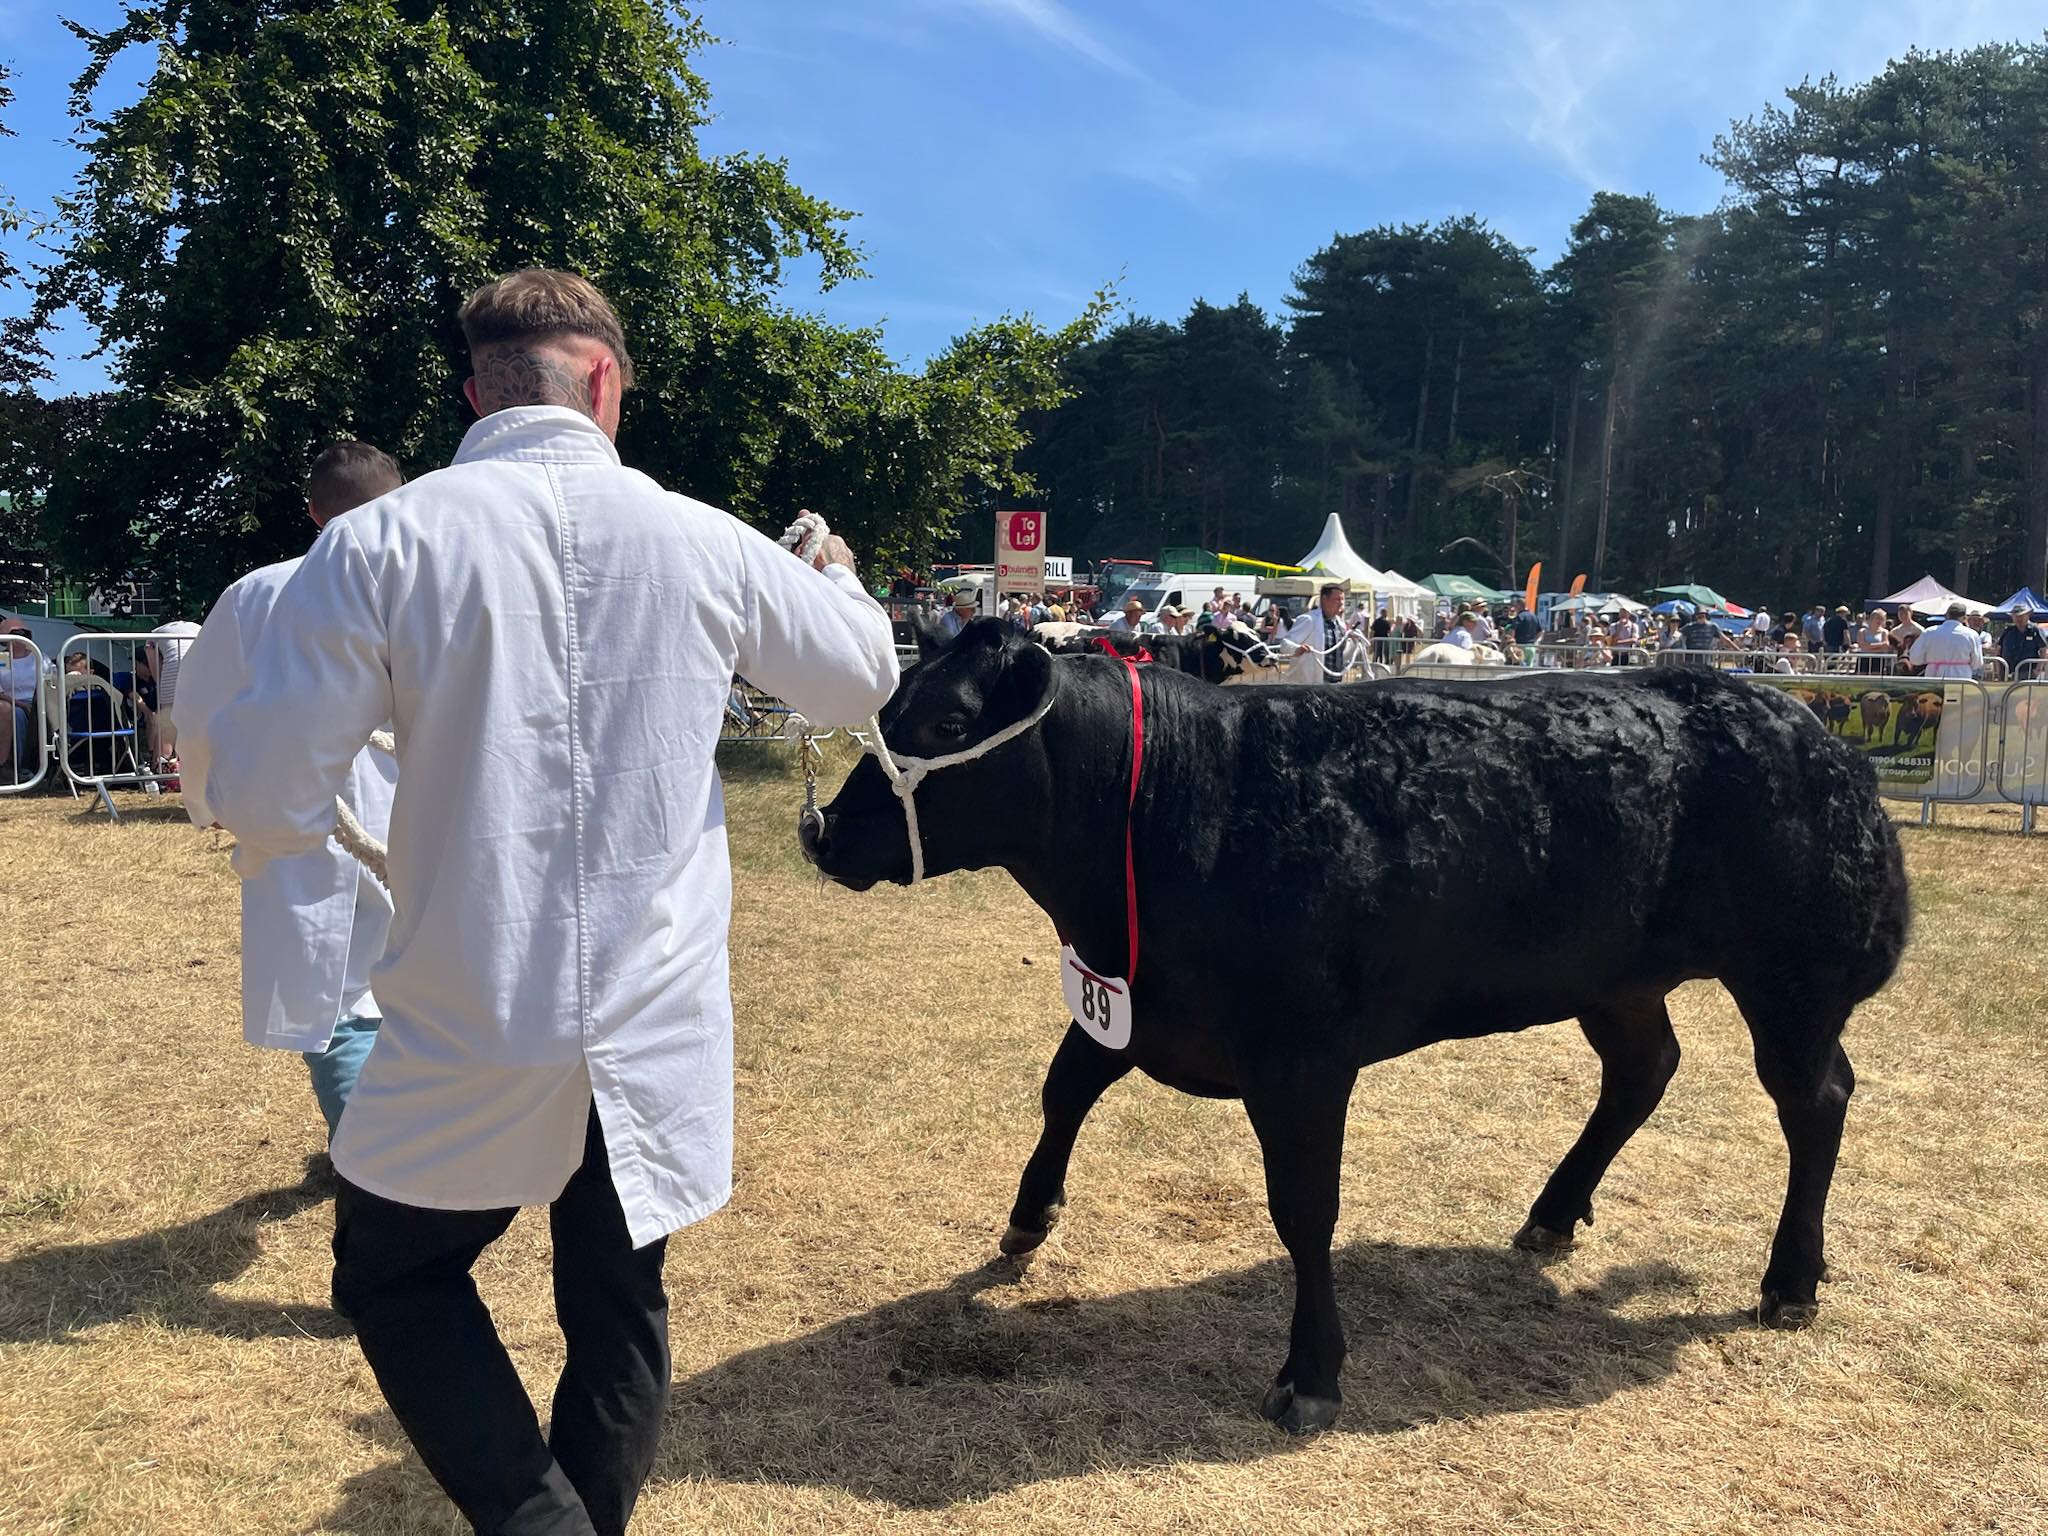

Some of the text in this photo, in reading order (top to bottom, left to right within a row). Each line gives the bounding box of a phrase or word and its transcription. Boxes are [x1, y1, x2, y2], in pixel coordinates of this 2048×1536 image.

[1021, 517, 1035, 530] To
[1016, 532, 1036, 546] Let
[1044, 562, 1067, 577] RILL
[1869, 756, 1932, 766] 01904 488333
[1082, 976, 1110, 1030] 89
